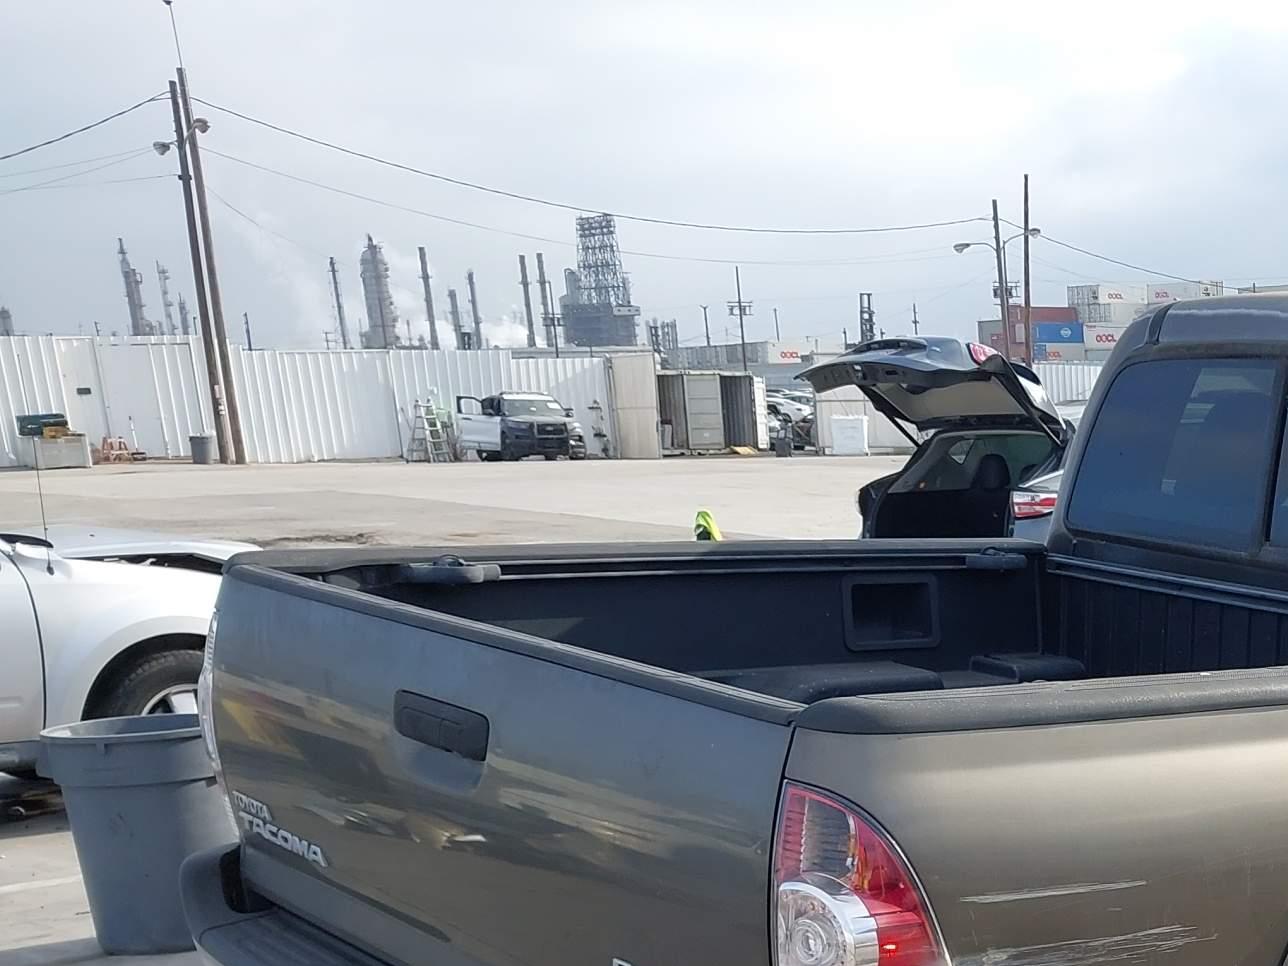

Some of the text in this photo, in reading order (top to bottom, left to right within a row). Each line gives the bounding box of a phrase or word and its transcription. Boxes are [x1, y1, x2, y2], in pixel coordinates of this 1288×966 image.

[1095, 333, 1117, 343] OOCL
[232, 790, 273, 821] TOYOTA
[238, 810, 328, 867] TACOMA
